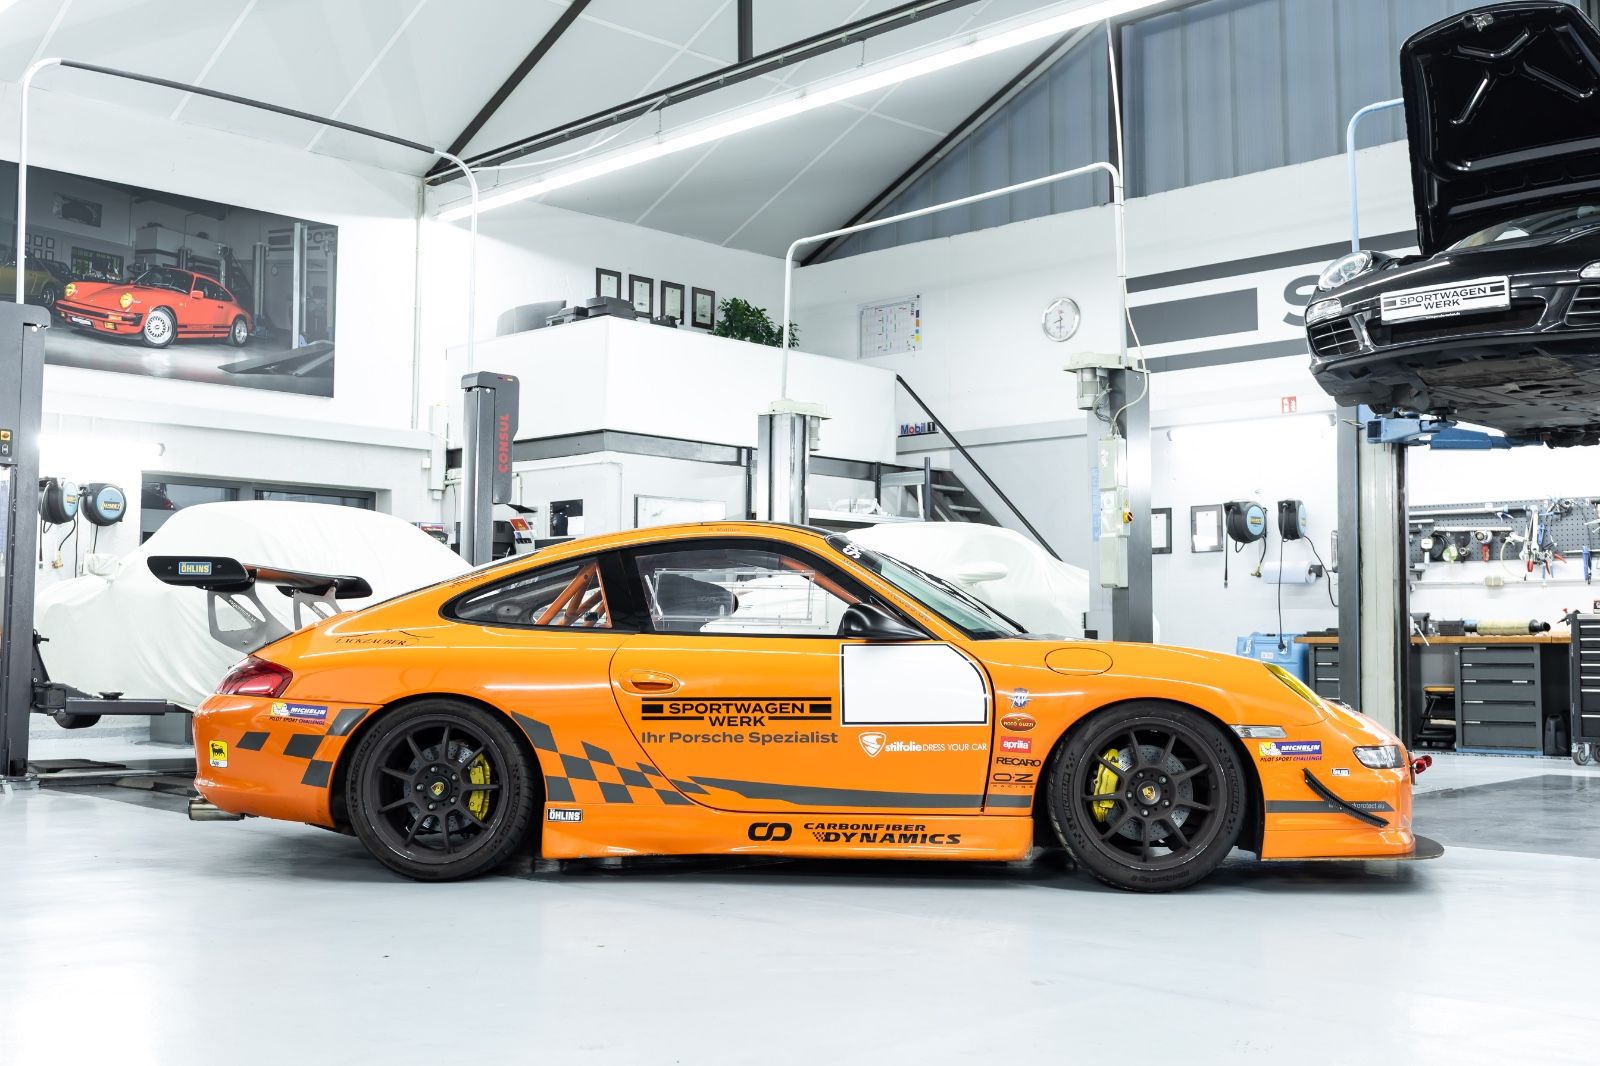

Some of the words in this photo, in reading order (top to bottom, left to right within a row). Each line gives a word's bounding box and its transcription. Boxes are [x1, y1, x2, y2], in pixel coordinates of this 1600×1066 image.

[1400, 286, 1487, 305] SPORTWAGEN
[1424, 299, 1461, 310] WERK
[900, 422, 926, 435] Mobil
[498, 414, 509, 473] CONSUL
[181, 561, 210, 574] ÖHLINS
[290, 706, 327, 716] MICHELIN
[669, 702, 805, 714] SPORTWAGEN
[708, 715, 766, 727] WERK
[641, 732, 666, 744] Ihr
[669, 731, 745, 744] Porsche
[748, 731, 839, 746] Spezialist
[884, 741, 923, 752] stilfolie
[922, 743, 946, 752] DRESS
[947, 743, 970, 752] YOUR
[971, 743, 988, 752] CAR
[1003, 740, 1029, 750] aprilia
[1280, 744, 1320, 752] MICHELIN
[996, 757, 1042, 768] RECARO
[549, 809, 581, 821] ÖHLINS
[803, 822, 927, 832] CARBONFIBER
[824, 832, 961, 845] DYNAMICS
